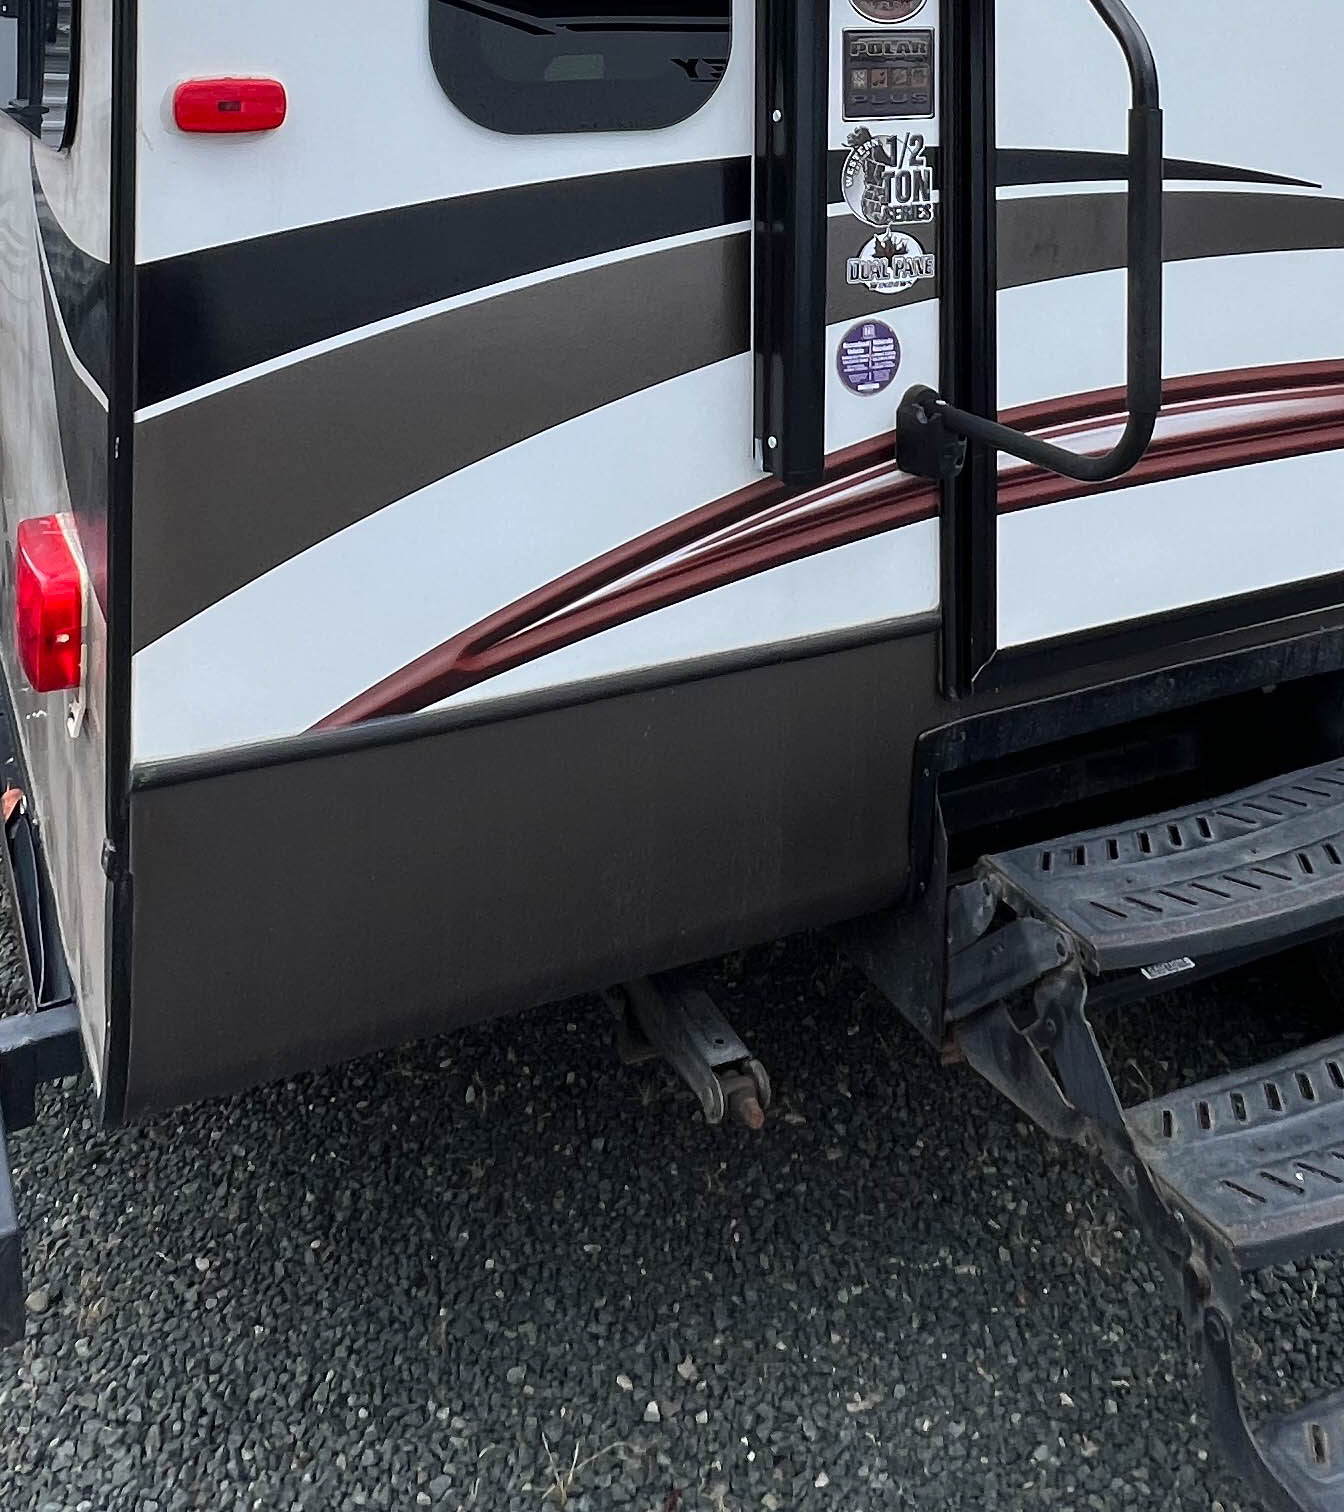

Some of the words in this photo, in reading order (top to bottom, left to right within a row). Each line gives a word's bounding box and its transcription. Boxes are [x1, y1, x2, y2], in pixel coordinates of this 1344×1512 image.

[850, 40, 929, 57] POLAR
[850, 93, 929, 106] PLUS
[845, 138, 880, 188] WESTERN
[885, 132, 924, 169] 1/2
[881, 170, 931, 204] TON
[849, 258, 890, 281] DUAL
[893, 255, 934, 278] PANE
